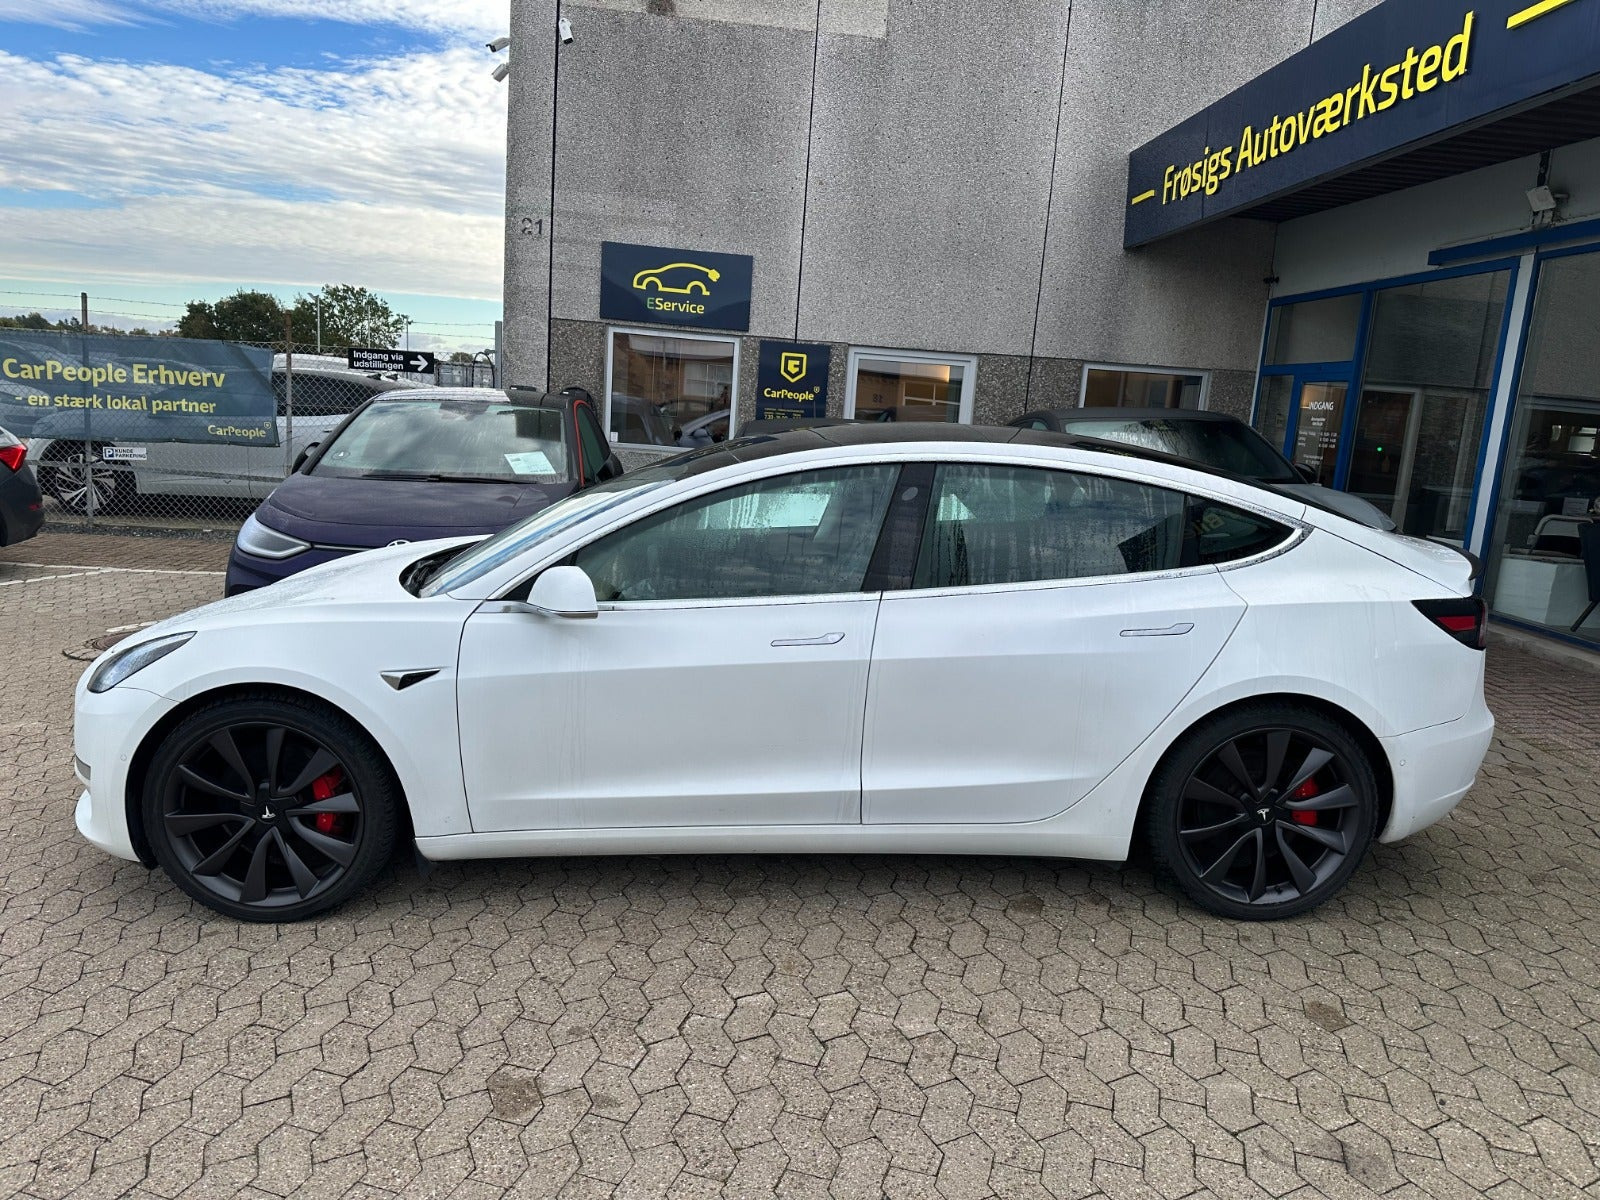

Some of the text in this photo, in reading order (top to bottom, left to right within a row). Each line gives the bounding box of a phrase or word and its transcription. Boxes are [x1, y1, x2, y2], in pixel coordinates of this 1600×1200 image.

[1163, 11, 1474, 204] Frøsigs Autoværksted
[521, 217, 543, 235] 21
[646, 297, 705, 314] EService
[353, 350, 404, 360] Indgang via
[2, 358, 225, 388] CarPeople Erhverv
[353, 360, 404, 370] udstillingen
[763, 387, 815, 402] CarPeople
[28, 394, 49, 406] en
[53, 393, 103, 409] stærk
[106, 395, 148, 411] lokal
[152, 399, 216, 415] partner
[1309, 401, 1334, 410] INDGANG
[207, 424, 267, 438] CarPeople
